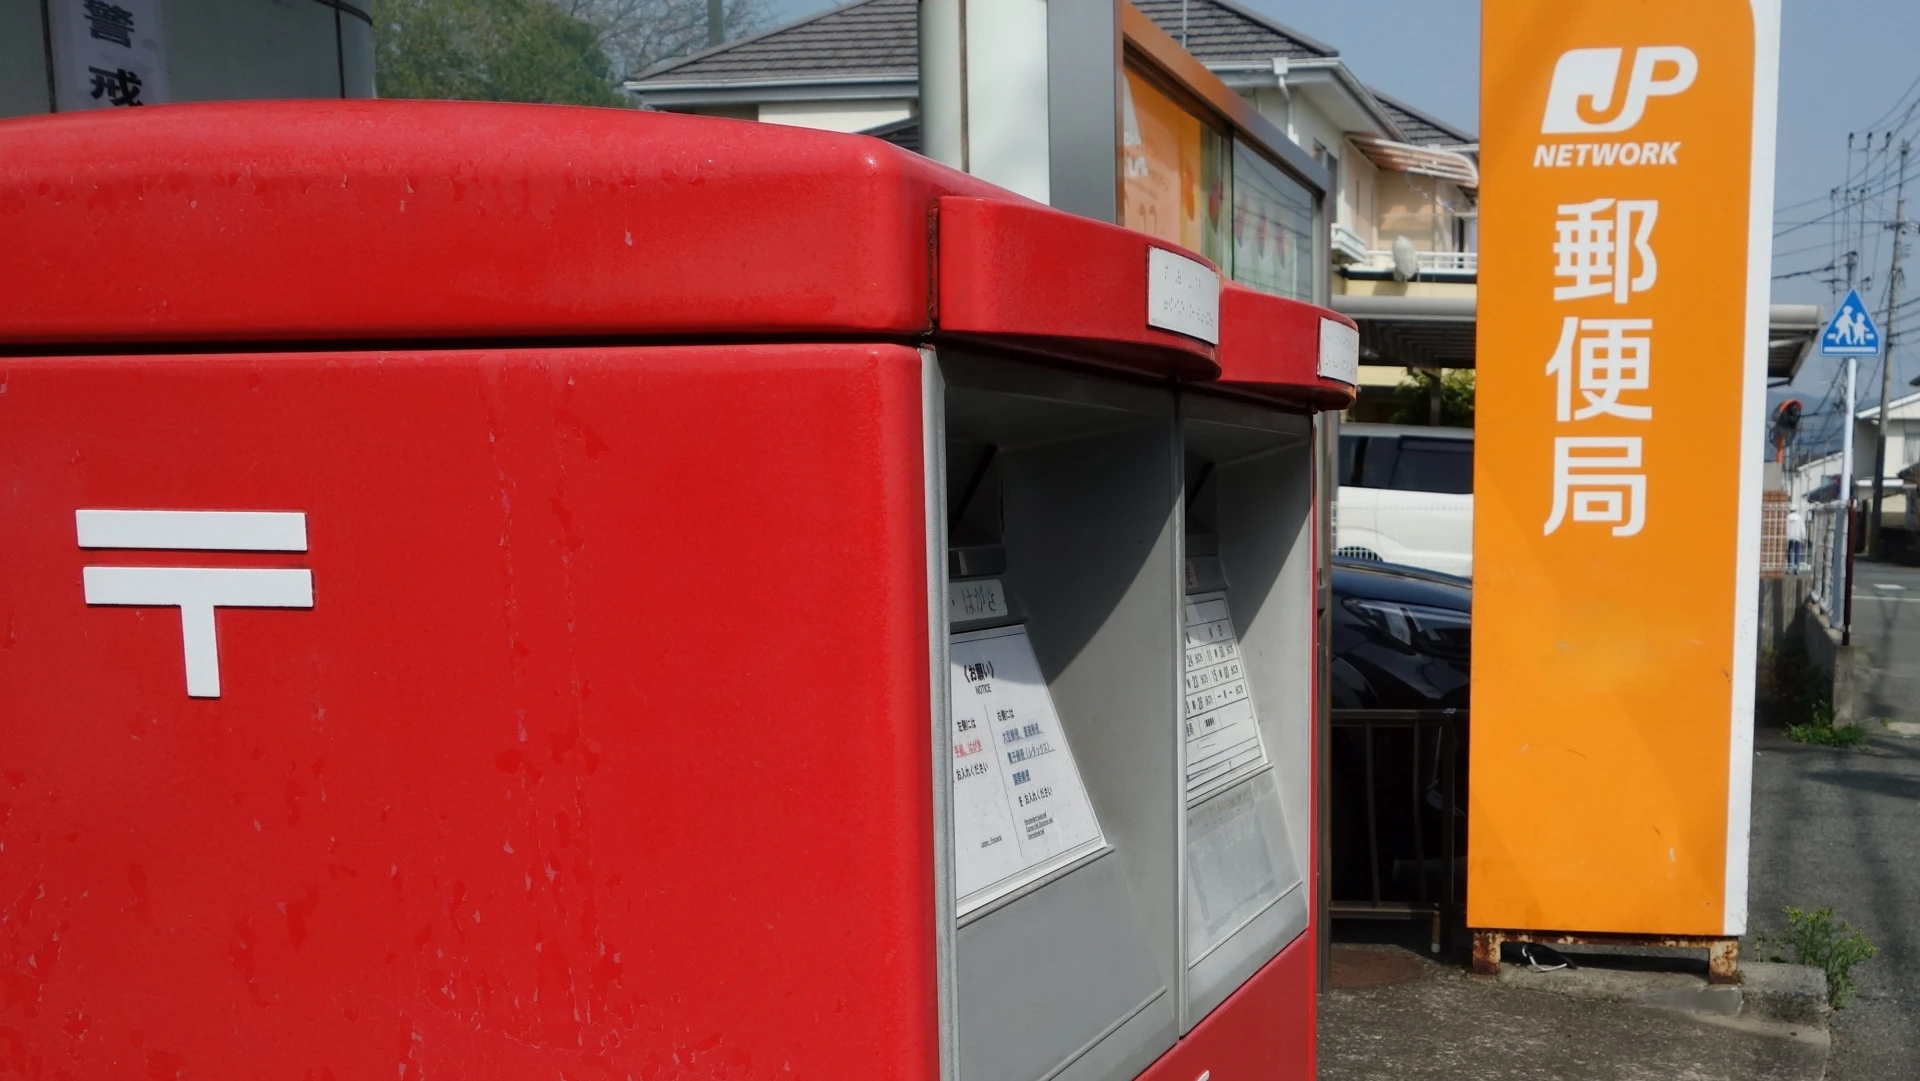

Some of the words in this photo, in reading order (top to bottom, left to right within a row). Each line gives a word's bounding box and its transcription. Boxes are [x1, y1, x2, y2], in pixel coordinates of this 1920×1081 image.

[83, 0, 144, 107] 警戒
[1541, 46, 1698, 134] JP
[1533, 141, 1681, 168] NETWORK
[1544, 198, 1658, 537] 郵便局
[975, 684, 991, 695] NOTICE
